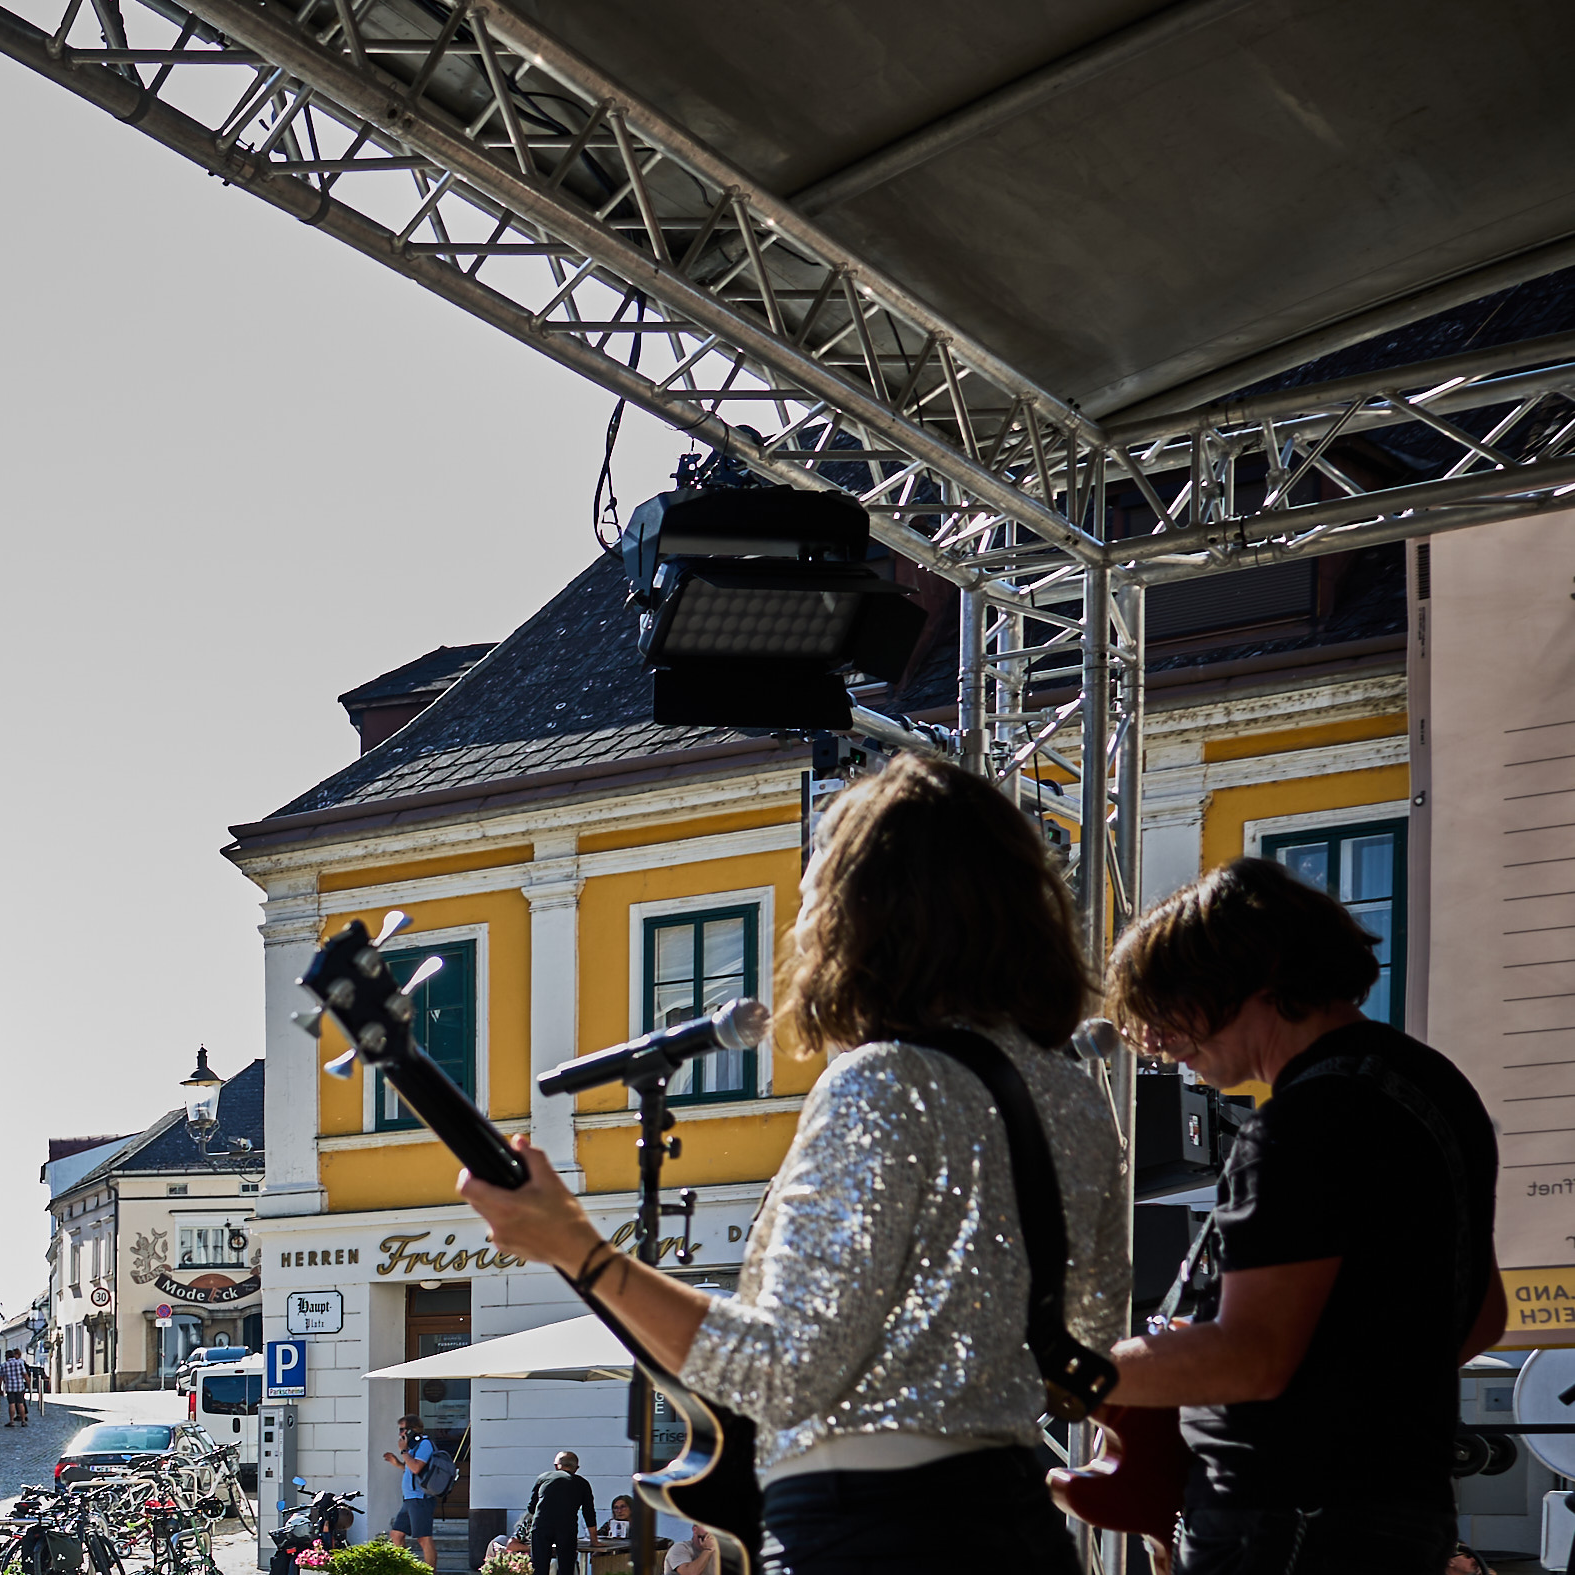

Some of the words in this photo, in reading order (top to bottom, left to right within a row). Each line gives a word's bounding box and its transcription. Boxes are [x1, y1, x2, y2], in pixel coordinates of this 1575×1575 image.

[281, 1249, 359, 1268] HERREN
[96, 1291, 107, 1302] 30
[162, 1280, 206, 1301] Mode
[208, 1287, 238, 1303] Eck
[297, 1298, 332, 1316] Haupt-
[276, 1344, 299, 1384] P
[269, 1387, 304, 1395] Parkscheine
[654, 1391, 665, 1415] GE
[652, 1428, 686, 1443] Frise
